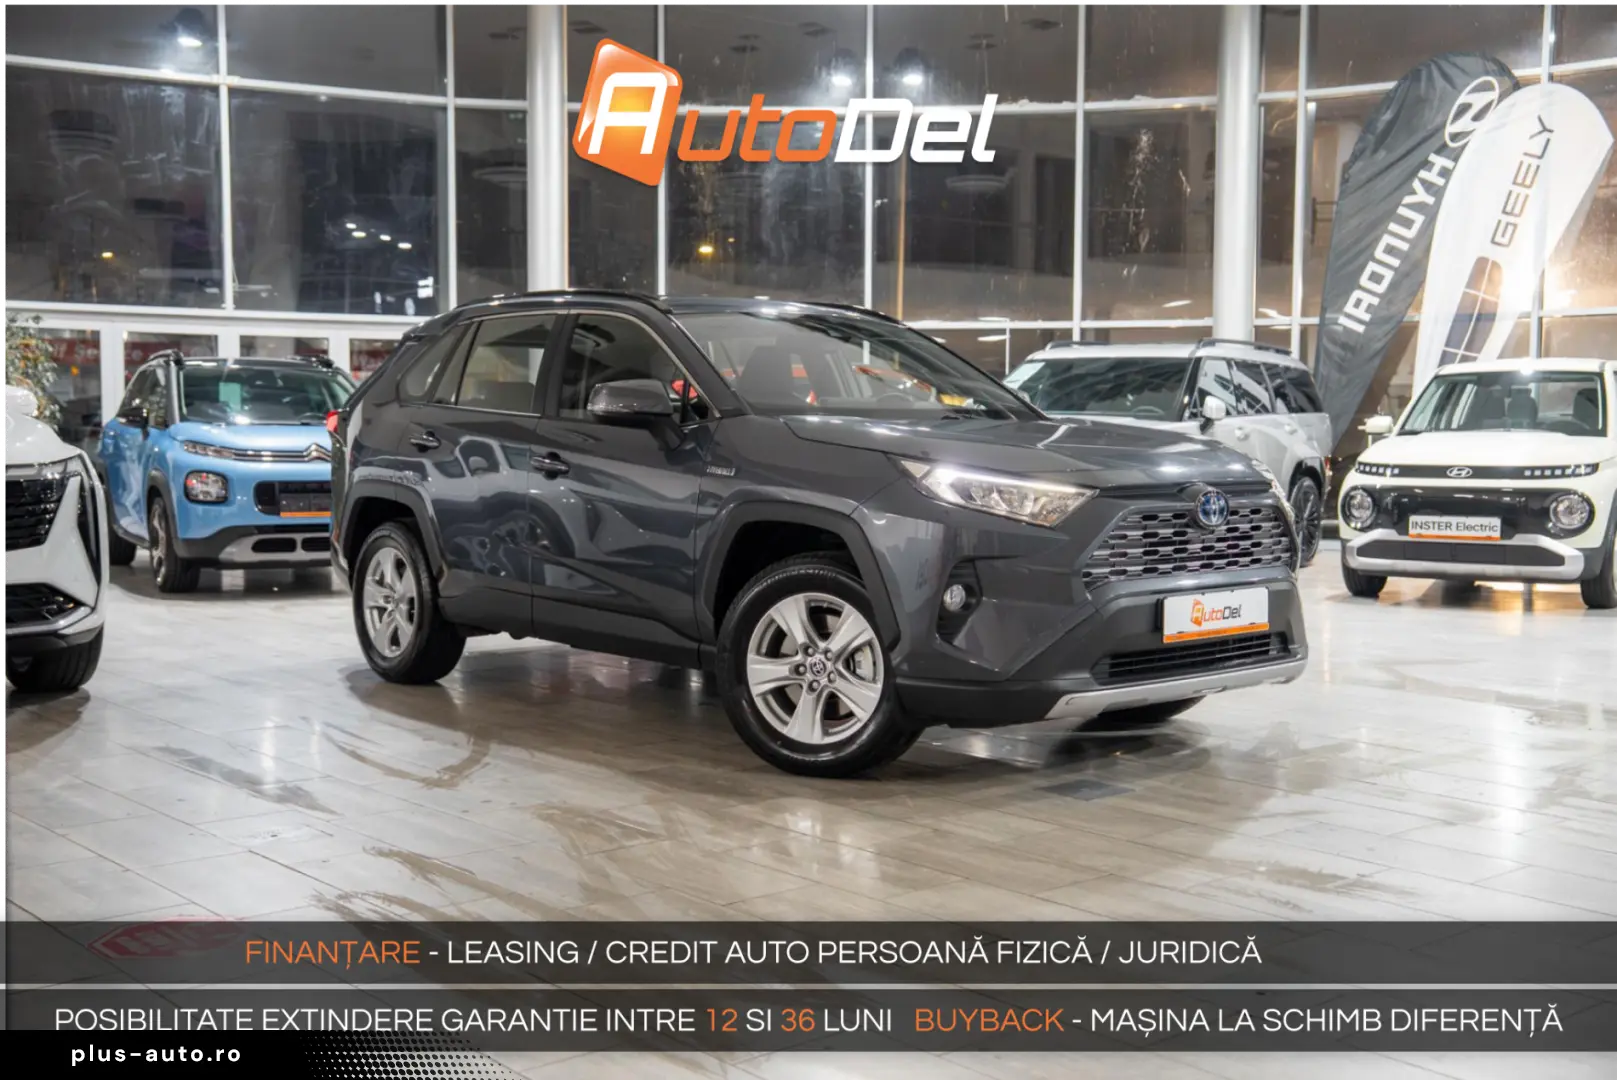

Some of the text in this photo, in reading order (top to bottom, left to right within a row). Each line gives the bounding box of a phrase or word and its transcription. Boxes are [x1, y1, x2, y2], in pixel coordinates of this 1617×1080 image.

[1490, 113, 1555, 248] GEELY
[1411, 520, 1498, 533] INSTER Electric
[1191, 602, 1242, 624] AutoDel
